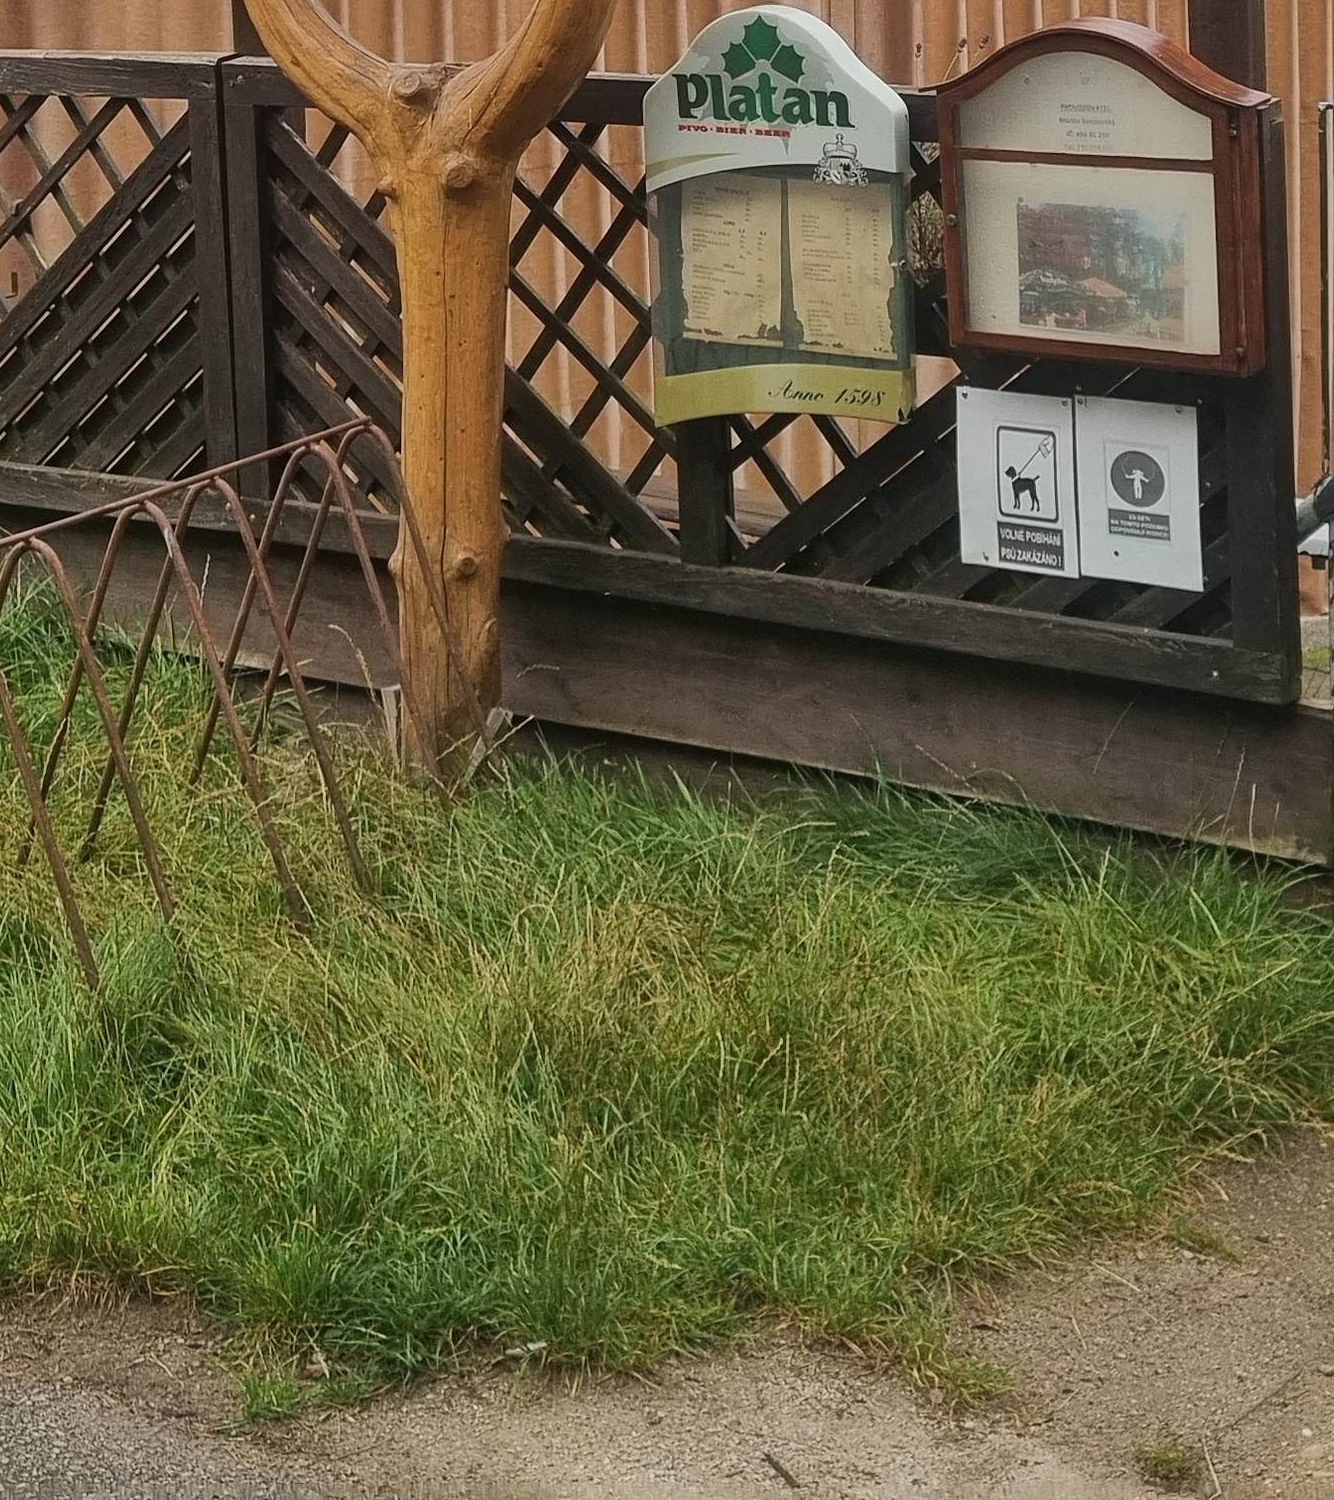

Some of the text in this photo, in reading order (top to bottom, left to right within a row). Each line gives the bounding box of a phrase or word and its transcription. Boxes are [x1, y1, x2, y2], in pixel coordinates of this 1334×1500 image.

[672, 72, 856, 129] Platan
[678, 124, 791, 138] PIVO BIER BEER
[768, 380, 886, 407] Anno 1598
